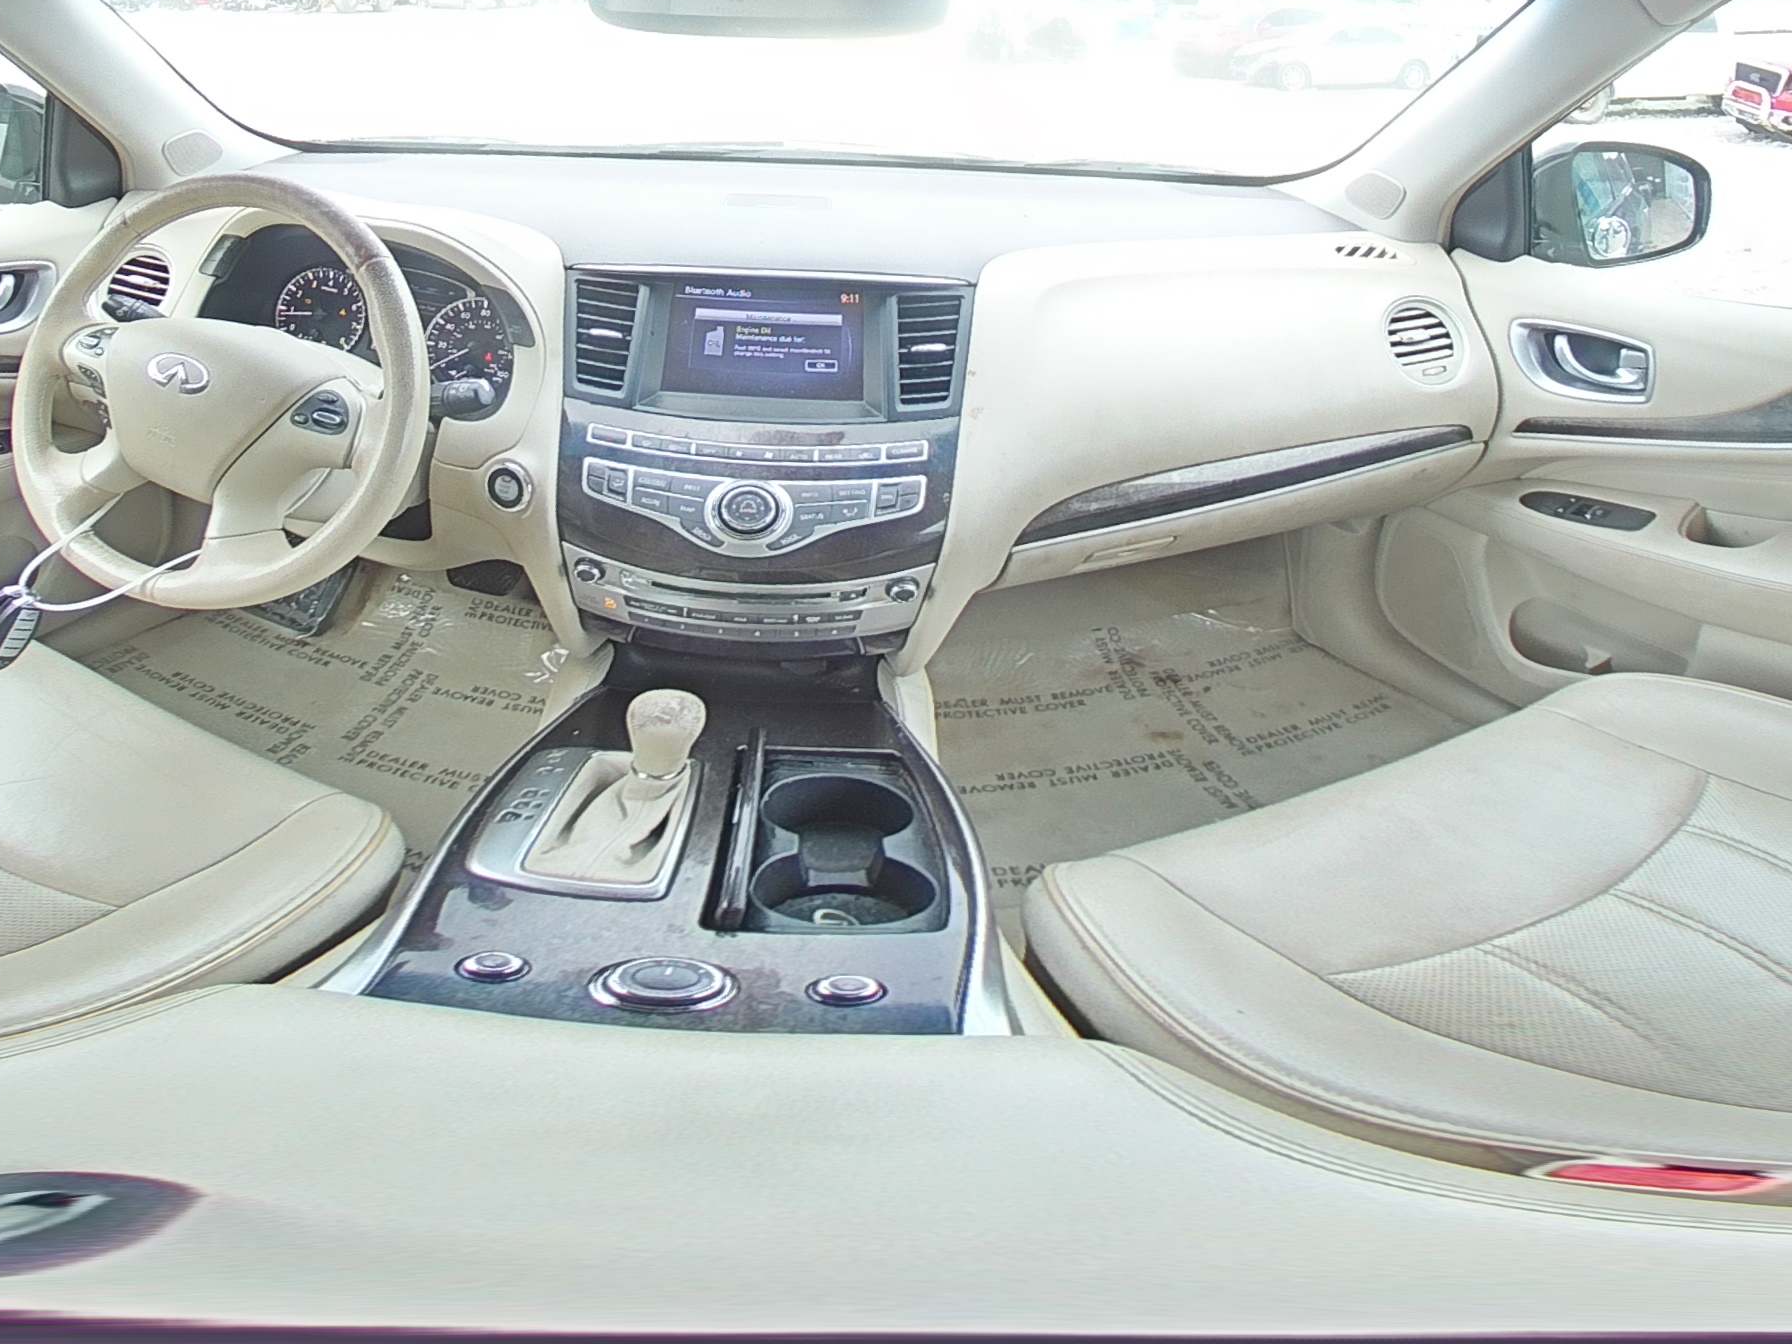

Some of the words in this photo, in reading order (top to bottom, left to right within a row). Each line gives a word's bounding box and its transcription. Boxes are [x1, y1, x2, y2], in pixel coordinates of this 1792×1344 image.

[840, 294, 859, 304] 9:11
[484, 600, 533, 617] DEALER
[287, 648, 332, 668] COVER
[312, 647, 369, 669] REMOVE
[1208, 651, 1251, 668] COVER
[135, 662, 189, 692] REMOVE
[171, 671, 216, 693] COVER
[188, 691, 231, 710] MUST
[431, 686, 495, 707] REMOVE
[471, 685, 522, 701] COVER
[935, 698, 988, 710] DEALER
[999, 694, 1042, 706] MUST
[1051, 684, 1114, 701] REMOVE
[217, 691, 301, 727] PROTECTIVE
[935, 707, 1028, 720] PROTECTIVE
[1035, 699, 1087, 712] COVER
[235, 710, 290, 735] DEALER
[1246, 723, 1302, 744] DEALER
[1308, 708, 1347, 726] MUST
[1255, 722, 1342, 754] PROTECTIVE
[1346, 703, 1392, 724] COVER
[365, 750, 430, 771] DEALER
[1065, 751, 1166, 774] PROTECTIVE
[1110, 759, 1175, 778] DEALER
[356, 759, 460, 790] PROTECTIVE
[995, 768, 1056, 781] COVER
[1050, 773, 1099, 787] MUST
[958, 781, 1037, 795] REMOVE
